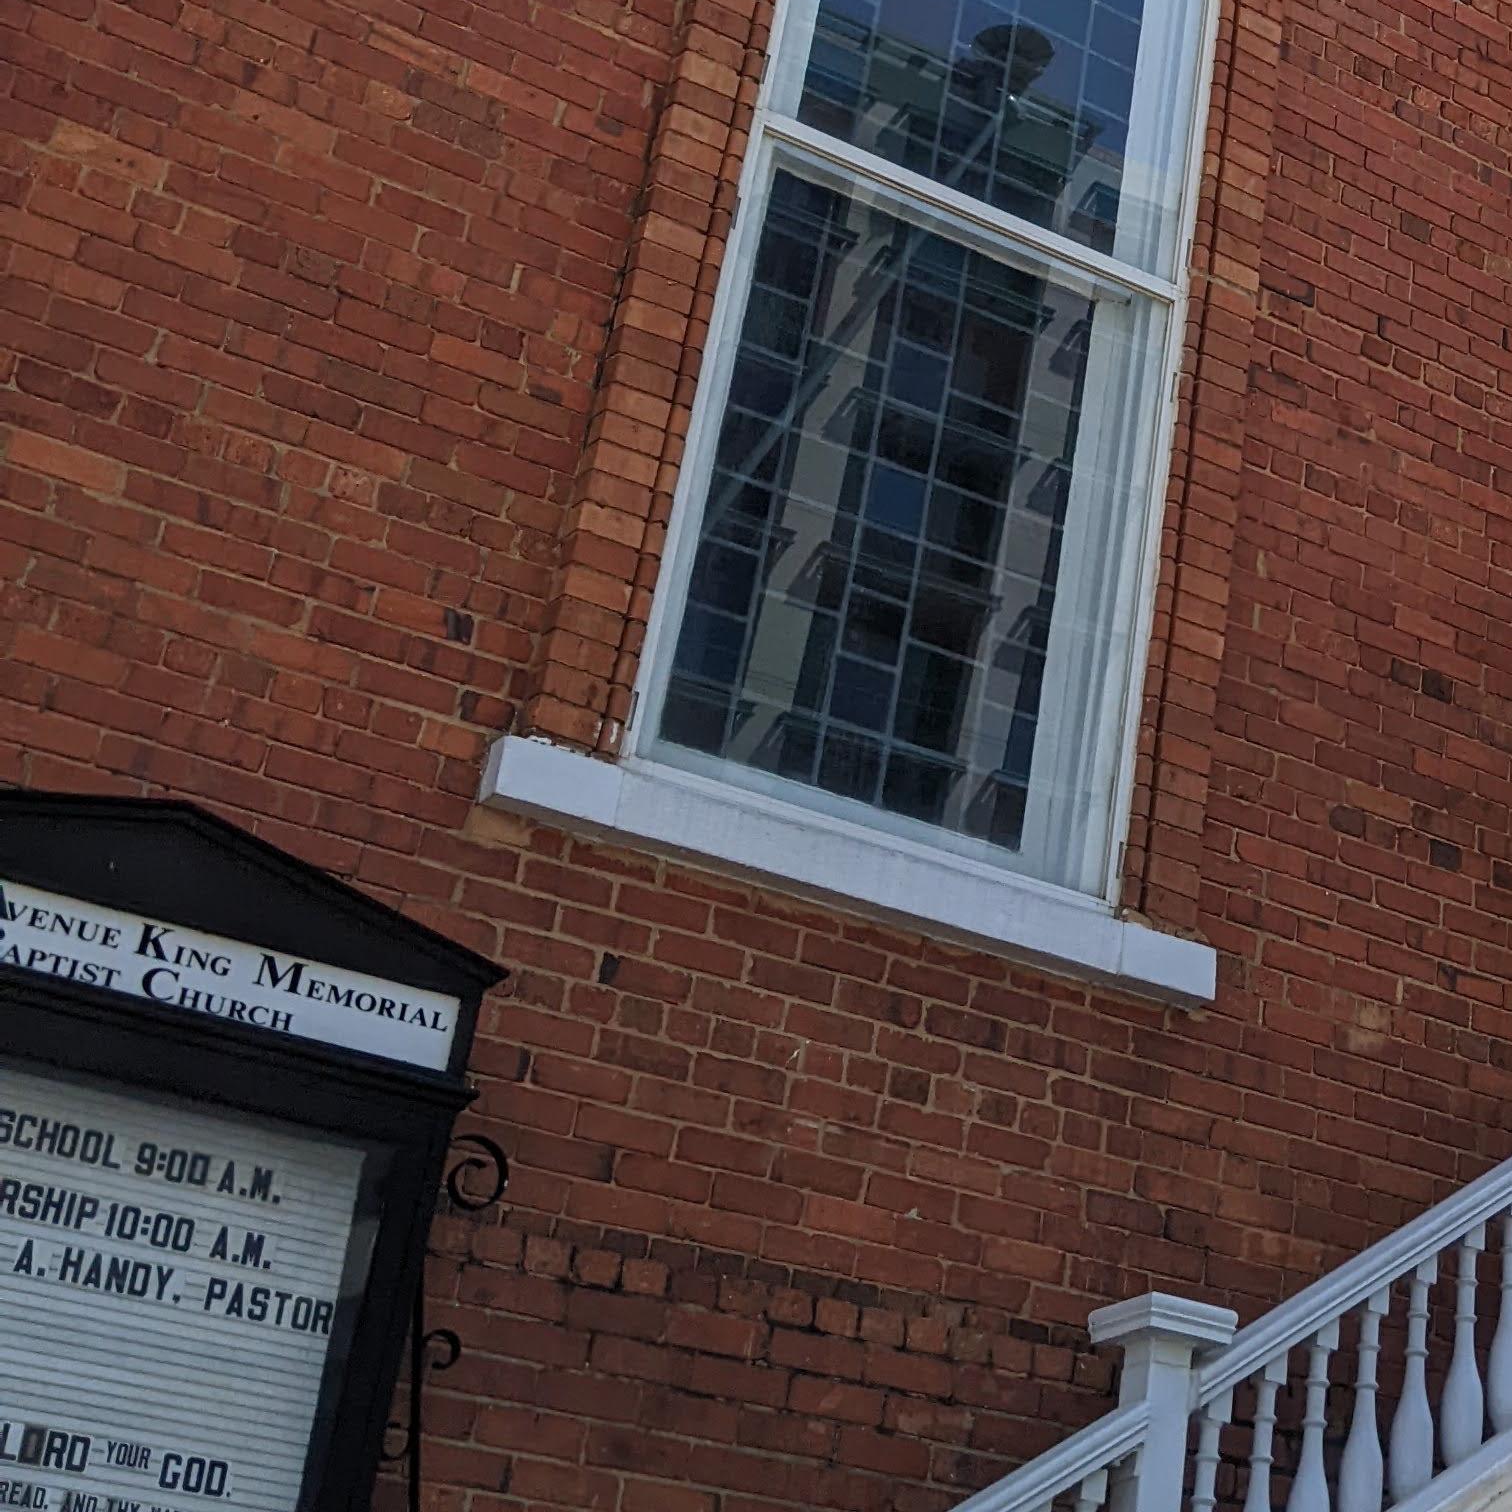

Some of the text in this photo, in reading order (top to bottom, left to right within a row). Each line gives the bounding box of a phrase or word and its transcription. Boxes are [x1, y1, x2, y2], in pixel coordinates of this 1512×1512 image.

[0, 928, 294, 1032] APTIST CHURCH
[134, 923, 232, 976] KING
[253, 953, 448, 1033] MEMORIAL
[0, 1109, 281, 1204] SCHOOL 9:00 A.M.
[105, 1203, 195, 1252] 10:00
[209, 1226, 271, 1270] A.M.
[13, 1239, 46, 1277] A.
[203, 1277, 334, 1334] PASTOR
[106, 1441, 151, 1469] YOUR
[158, 1453, 231, 1497] GOD.
